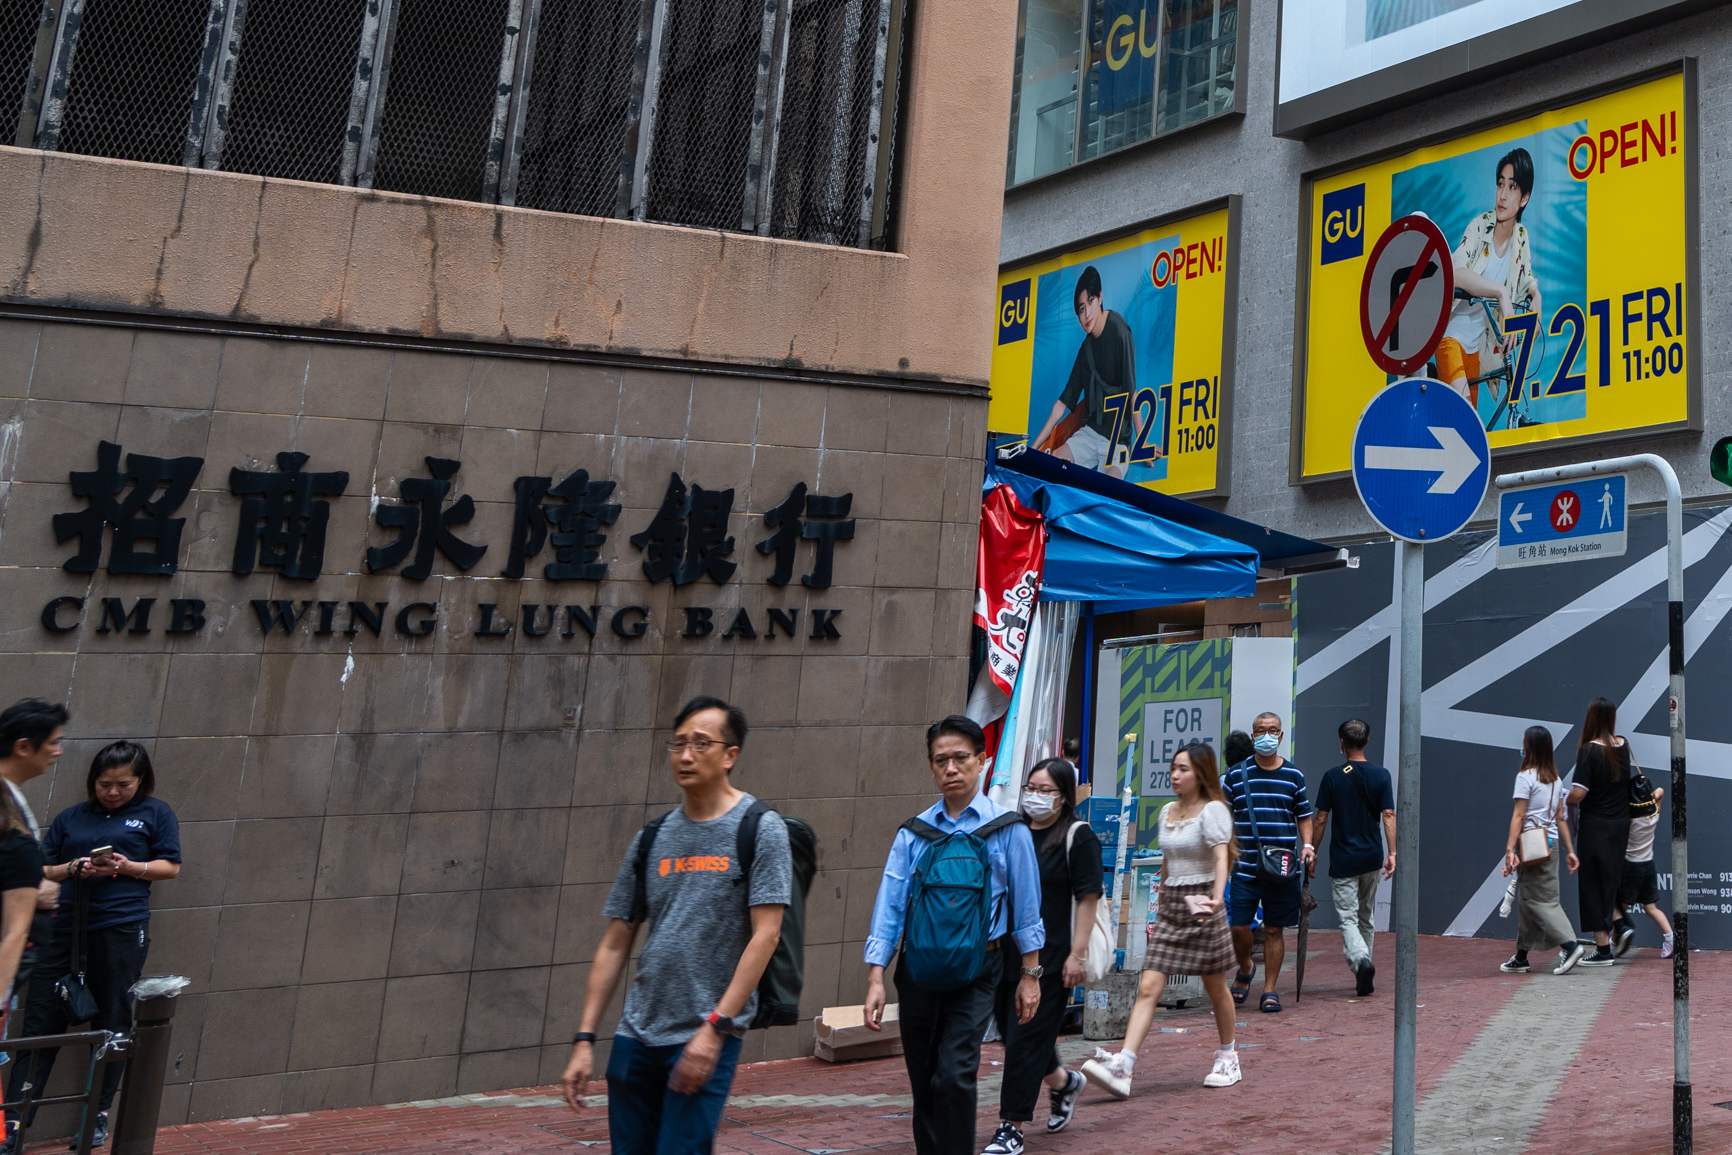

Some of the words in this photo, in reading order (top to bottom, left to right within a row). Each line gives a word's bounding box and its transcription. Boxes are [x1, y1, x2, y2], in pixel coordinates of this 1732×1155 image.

[1106, 8, 1158, 71] GU
[1568, 110, 1678, 181] OPEN!
[1324, 205, 1363, 244] GU
[1152, 236, 1223, 289] OPEN!
[1002, 297, 1029, 328] GU
[1502, 297, 1611, 404] 7.21
[1622, 282, 1683, 346] FRI
[1623, 342, 1683, 383] 11:00
[1104, 384, 1173, 467] 7.21
[1178, 376, 1218, 425] FRI
[1178, 423, 1215, 454] 11:00
[53, 440, 856, 589] 招商永隆銀行
[1518, 545, 1547, 559] 旺角站
[1550, 547, 1567, 557] Mong
[1568, 545, 1579, 553] Kok
[1580, 542, 1602, 552] Station
[41, 596, 206, 634] CMB
[250, 598, 438, 637] WING
[475, 602, 650, 638] LUNG
[682, 606, 844, 639] BANK
[1164, 708, 1202, 733] FOR
[1150, 771, 1171, 789] 278
[674, 856, 731, 873] K-SWISS
